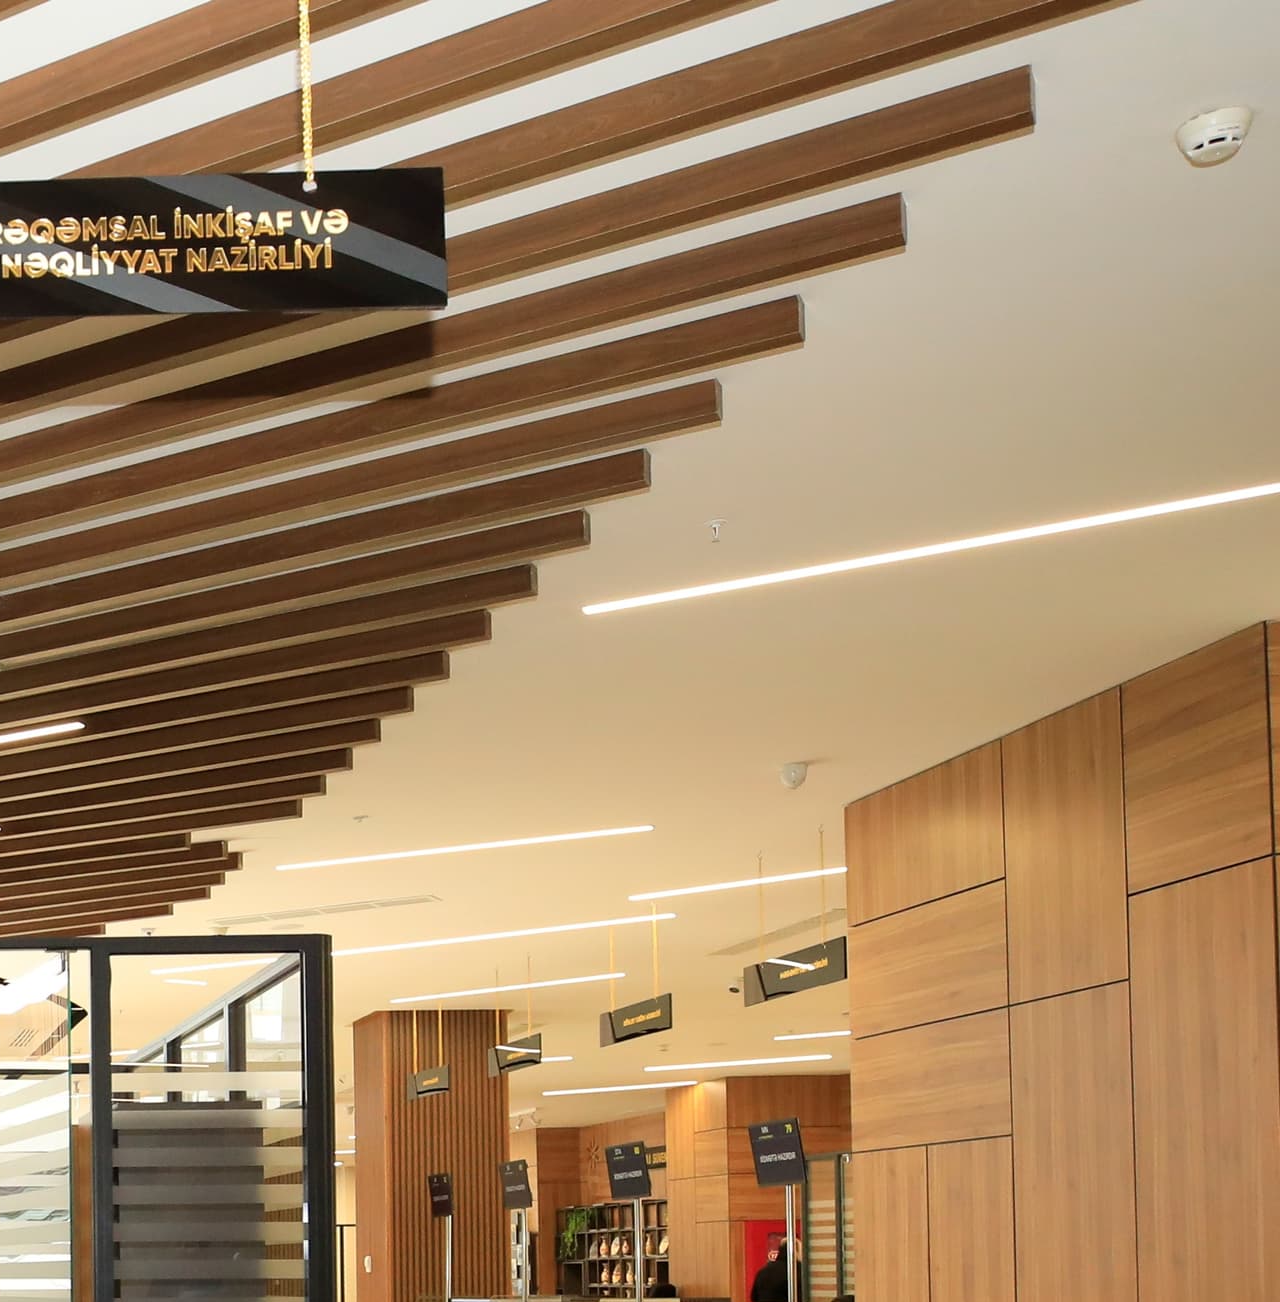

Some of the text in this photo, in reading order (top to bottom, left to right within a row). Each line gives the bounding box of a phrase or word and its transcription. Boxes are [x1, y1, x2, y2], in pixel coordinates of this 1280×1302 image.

[173, 205, 293, 243] İNKİŞAF
[300, 208, 350, 236] VƏ
[1, 237, 333, 279] NƏQLİYYAT NAZİRLİYİ
